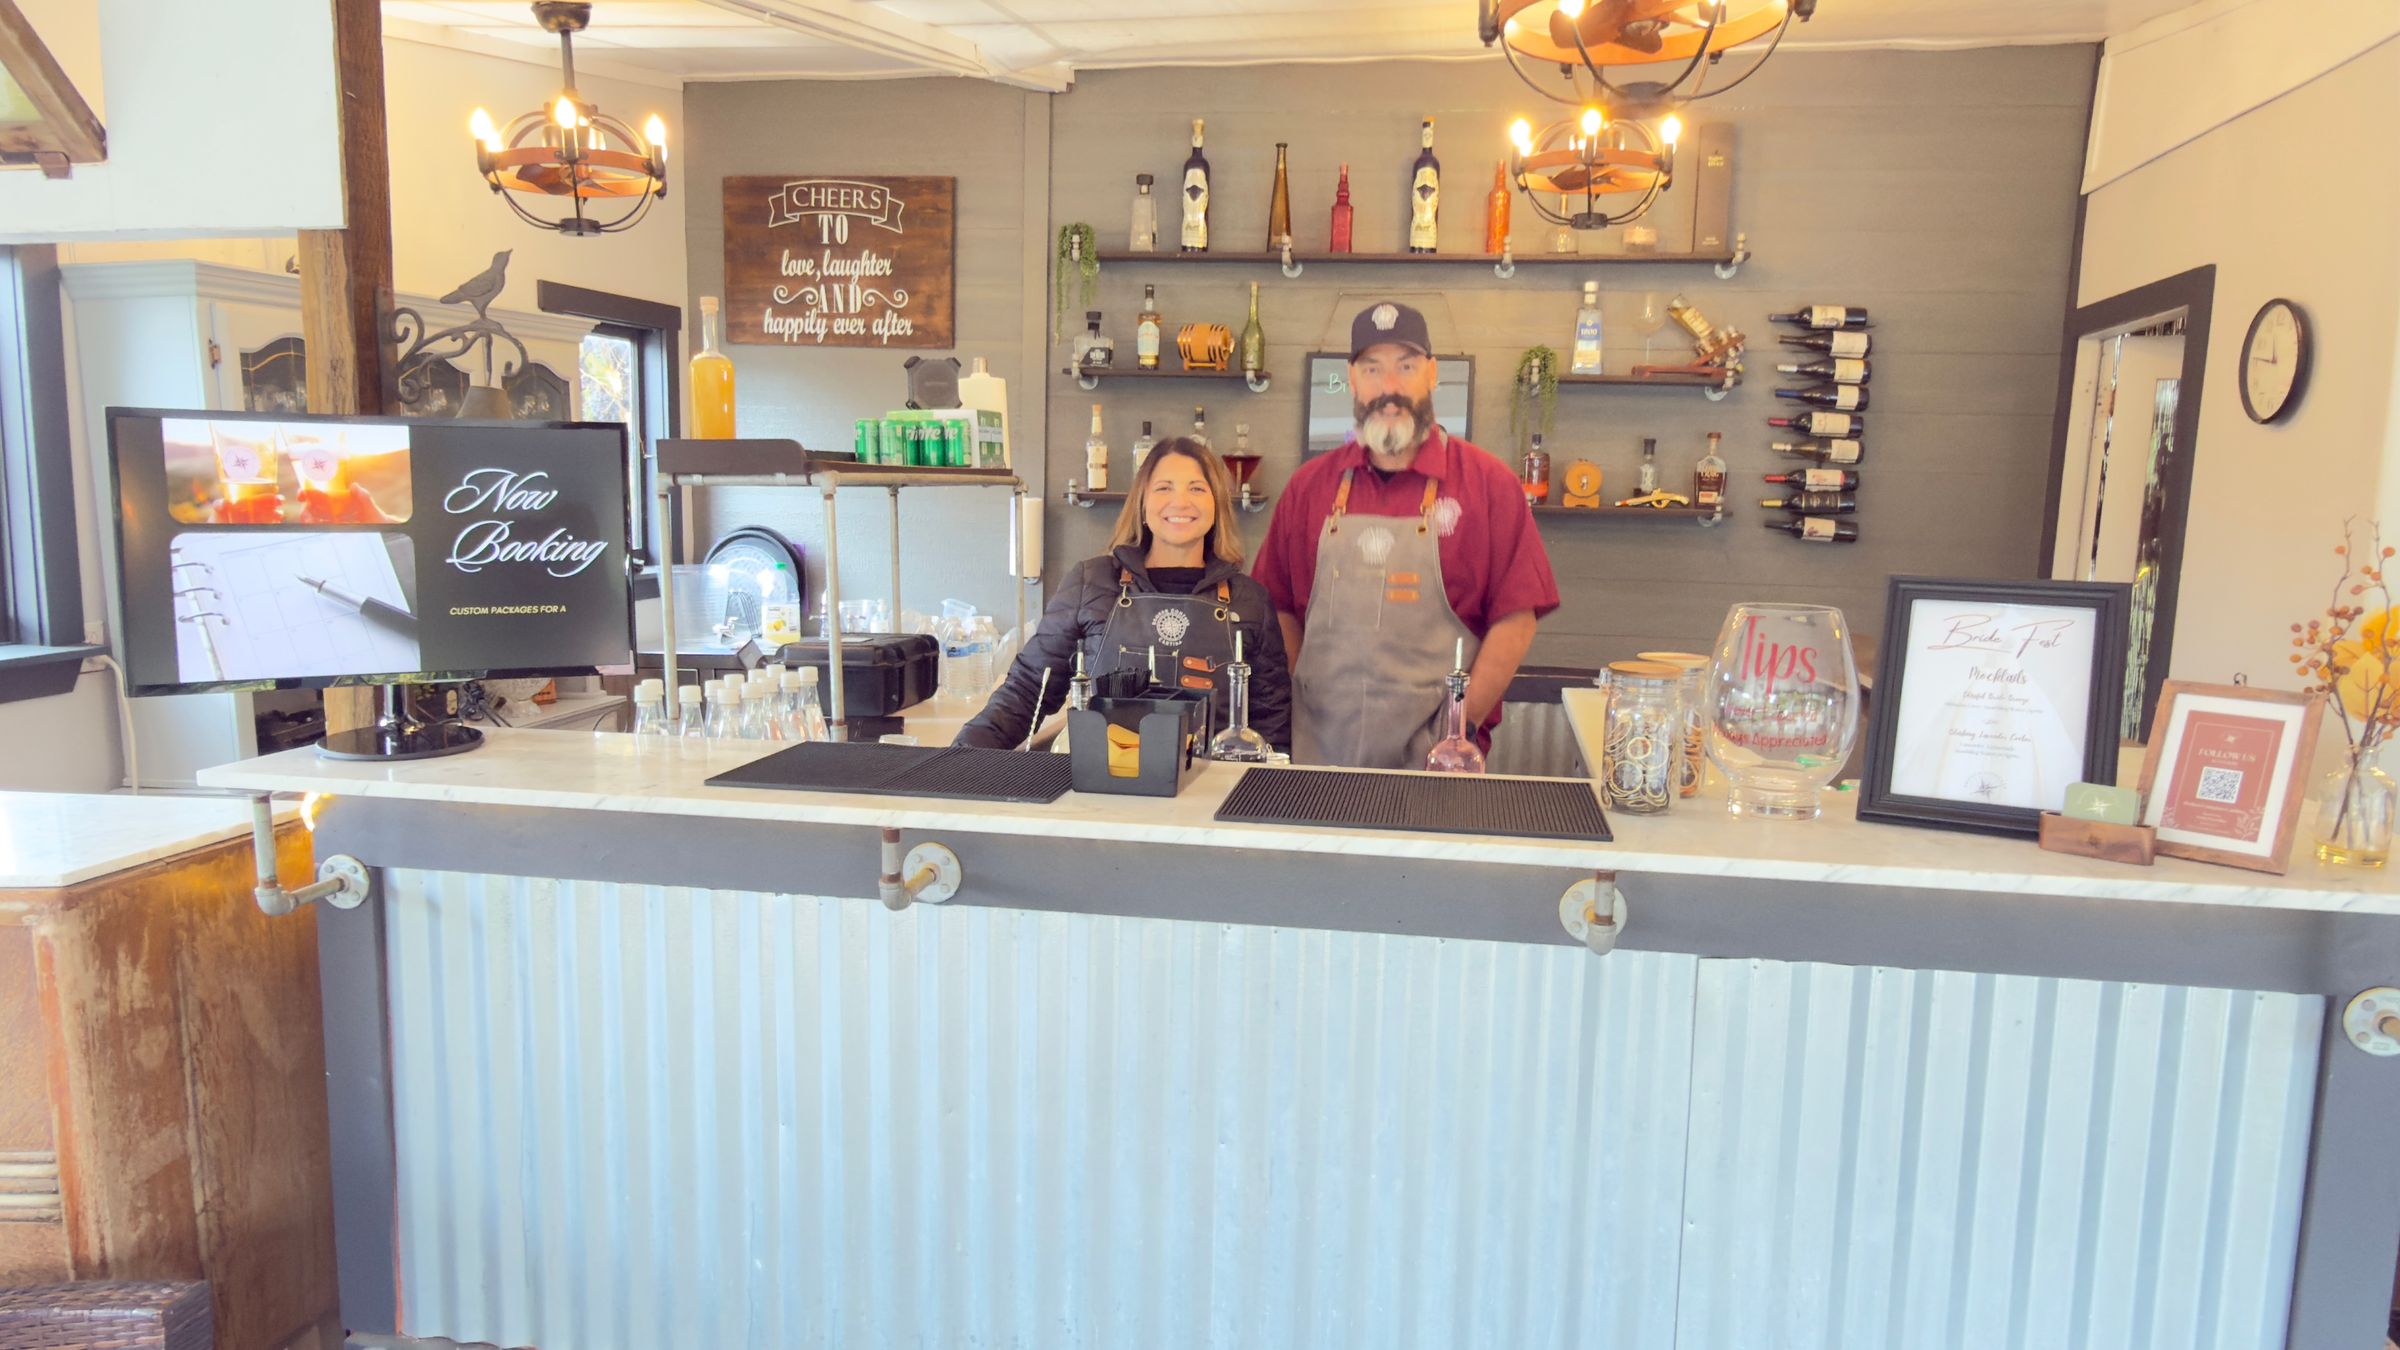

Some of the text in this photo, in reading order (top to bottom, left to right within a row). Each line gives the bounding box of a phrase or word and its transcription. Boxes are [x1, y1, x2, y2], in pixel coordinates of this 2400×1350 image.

[792, 187, 882, 210] CHEERS
[818, 214, 849, 245] TO
[817, 283, 863, 314] AND
[763, 307, 914, 345] happily ever after
[444, 468, 559, 514] Now
[445, 520, 609, 578] Booking
[450, 605, 567, 616] CUSTOM PACKAGES FOR A
[1927, 614, 2075, 659] Bride Fest
[1740, 615, 1818, 697] Tips
